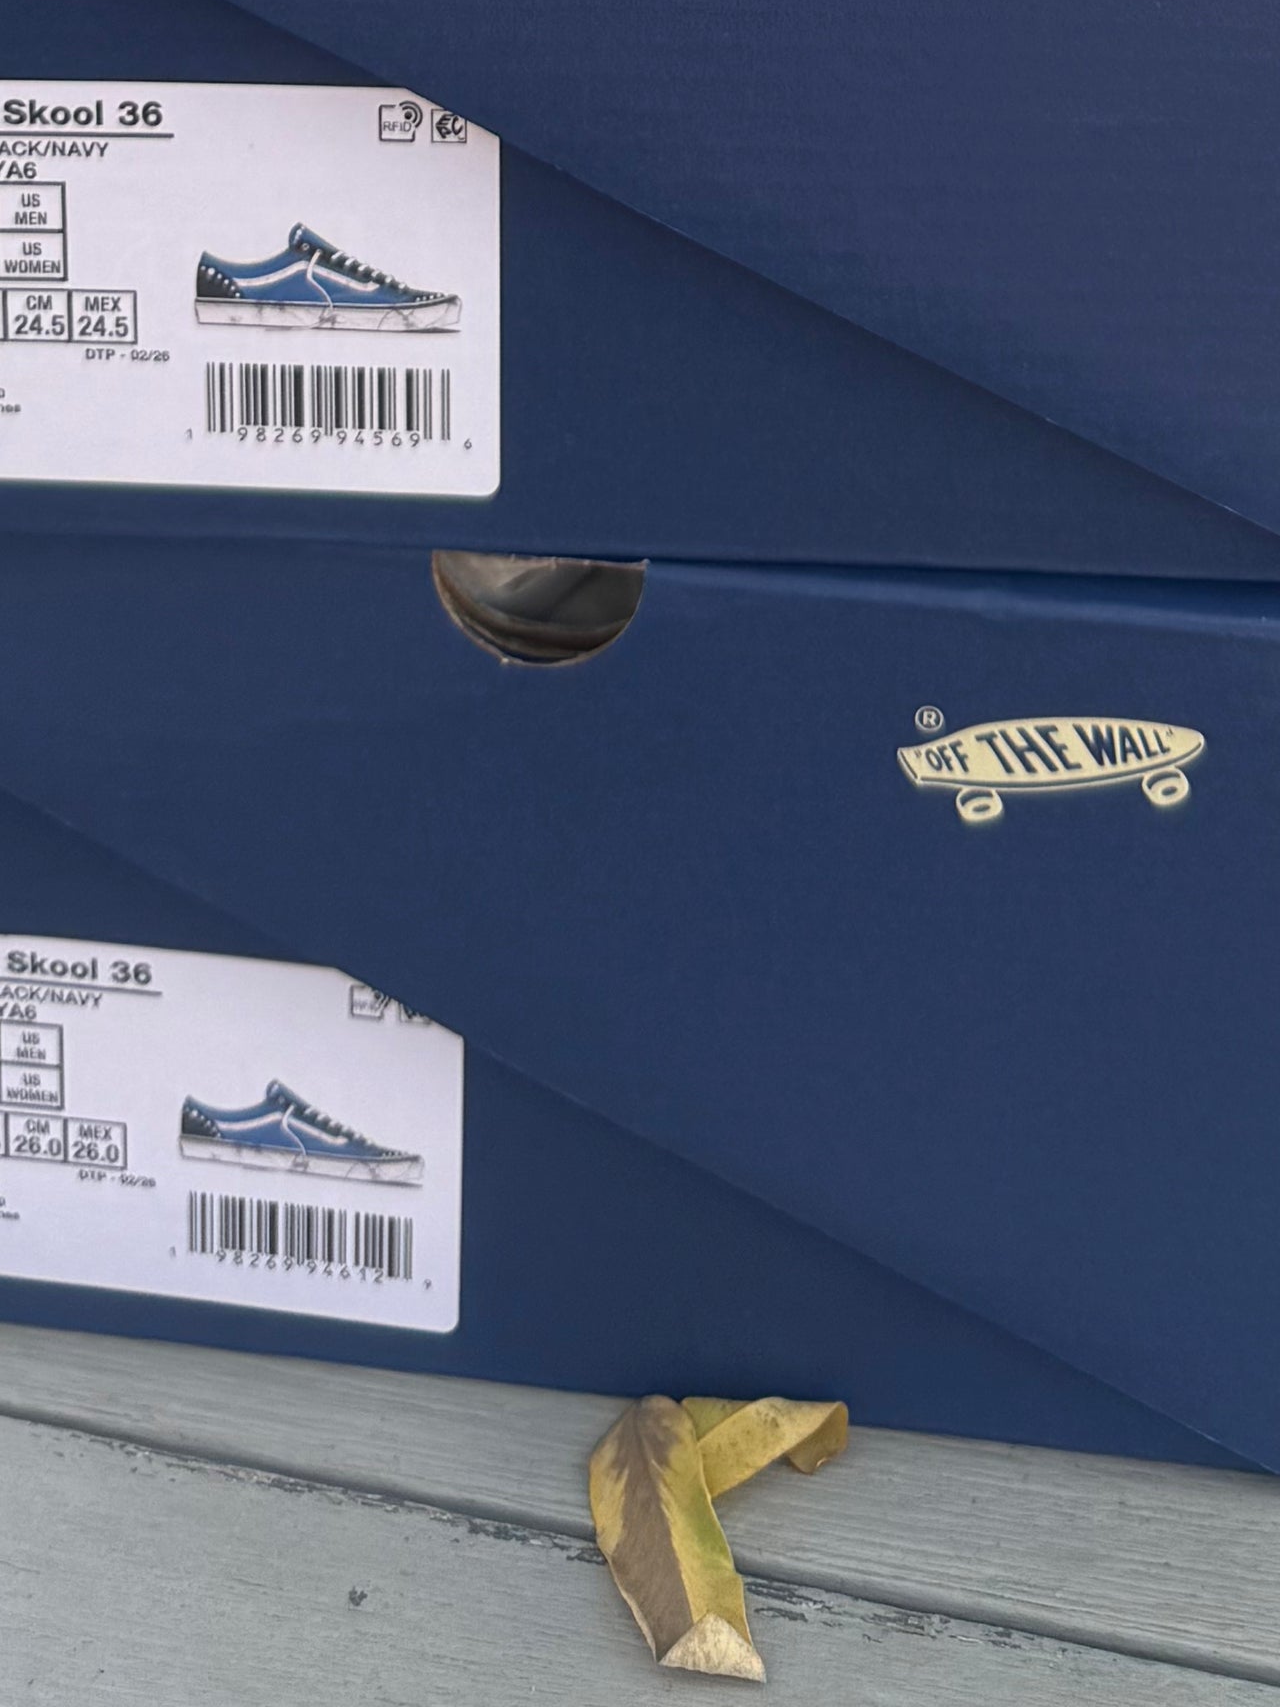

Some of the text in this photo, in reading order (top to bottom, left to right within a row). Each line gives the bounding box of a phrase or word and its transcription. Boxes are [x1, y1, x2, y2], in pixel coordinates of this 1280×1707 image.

[3, 99, 103, 126] Skool
[119, 101, 163, 126] 36
[383, 121, 412, 131] RFID
[21, 193, 40, 207] US
[15, 212, 47, 225] MEN
[22, 242, 42, 255] US
[4, 260, 61, 274] WOMEN
[26, 295, 52, 311] CM
[85, 297, 121, 312] MEX
[15, 314, 65, 336] 24.5
[78, 316, 129, 337] 24.5
[86, 348, 115, 360] DTP
[131, 349, 169, 362] 02/26
[237, 427, 321, 444] 98269
[337, 430, 420, 447] 94569
[464, 439, 472, 450] 6
[975, 725, 1082, 774] THE
[7, 951, 98, 979] Skool
[111, 960, 152, 985] 36
[22, 1032, 40, 1045] US
[17, 1047, 46, 1060] MEN
[23, 1074, 40, 1086] US
[7, 1089, 58, 1103] WOMEN
[26, 1119, 50, 1135] CM
[79, 1124, 112, 1141] MEX
[14, 1135, 61, 1157] 26.0
[72, 1141, 119, 1163] 26.0
[217, 1249, 292, 1271] 98269
[306, 1260, 384, 1284] 94612
